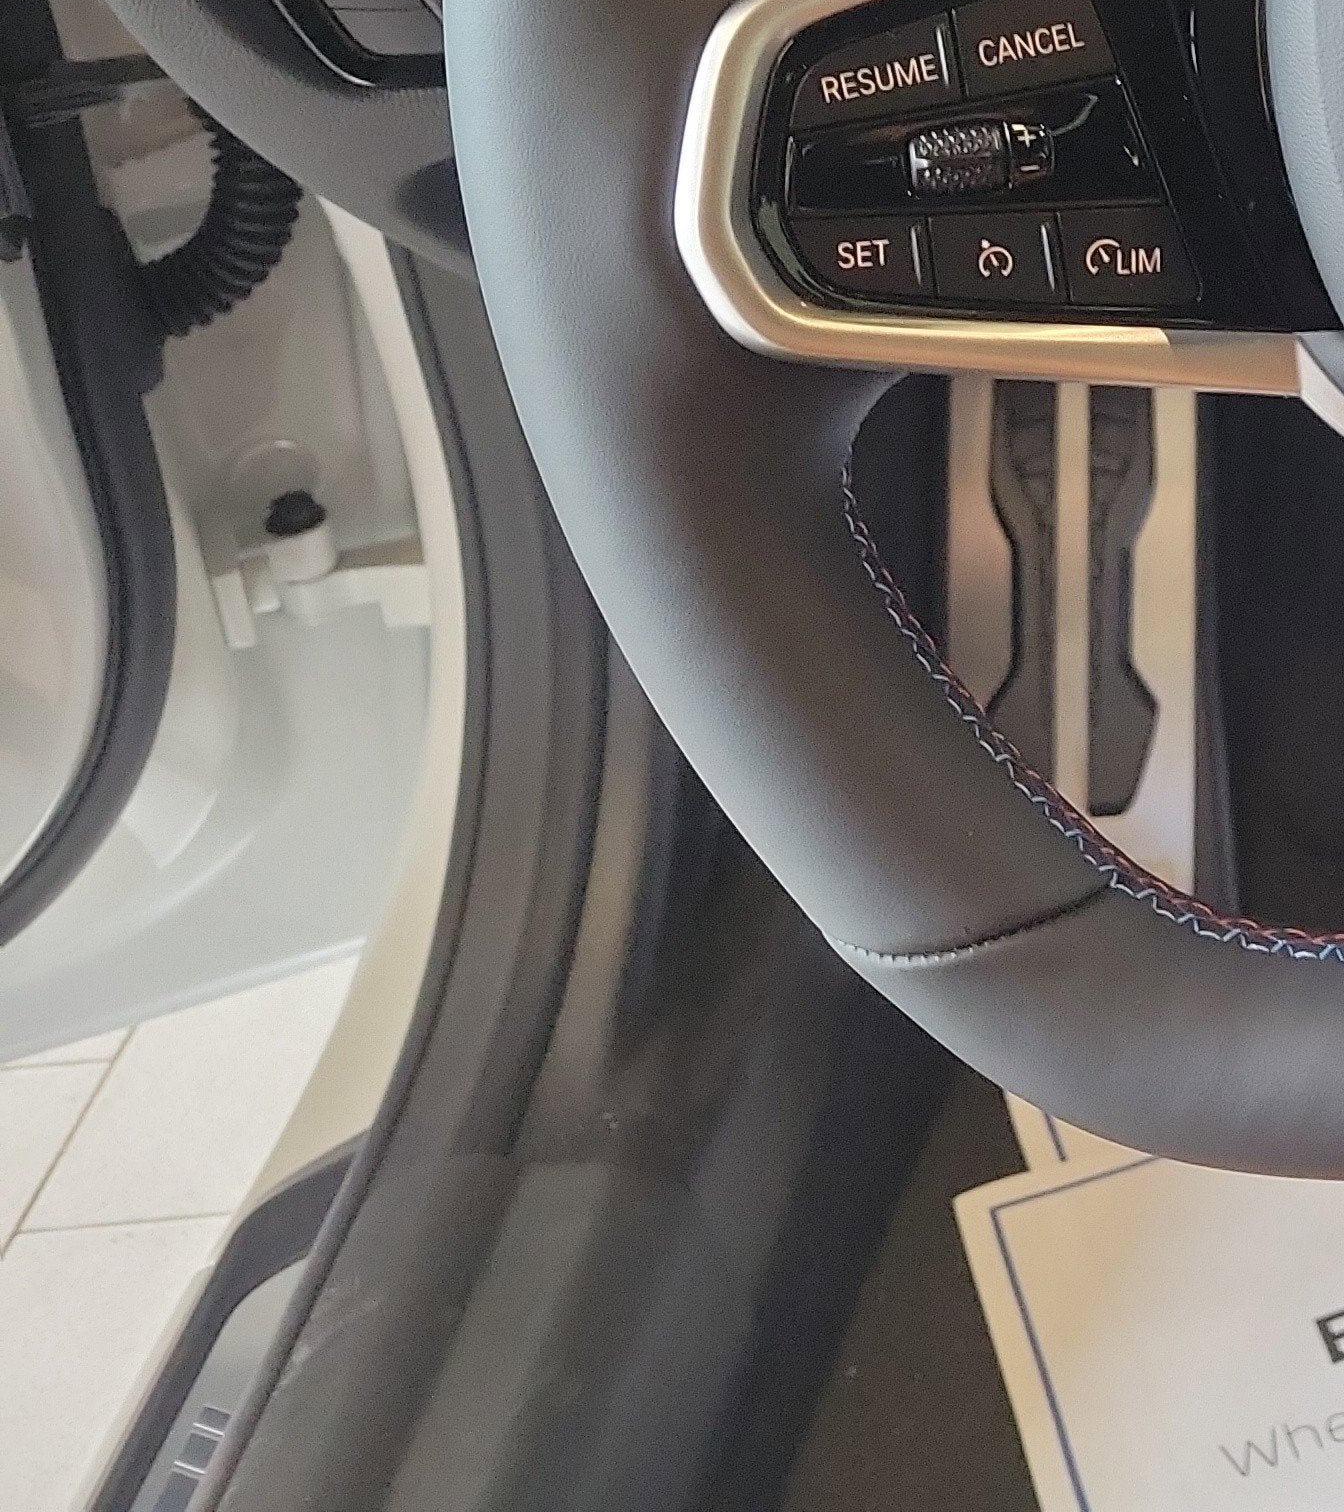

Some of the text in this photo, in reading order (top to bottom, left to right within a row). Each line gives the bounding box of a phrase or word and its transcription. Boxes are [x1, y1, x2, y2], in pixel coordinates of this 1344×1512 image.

[977, 22, 1085, 66] CANCEL
[820, 54, 940, 104] RESUME
[837, 238, 890, 269] SET
[1116, 247, 1162, 275] LIM
